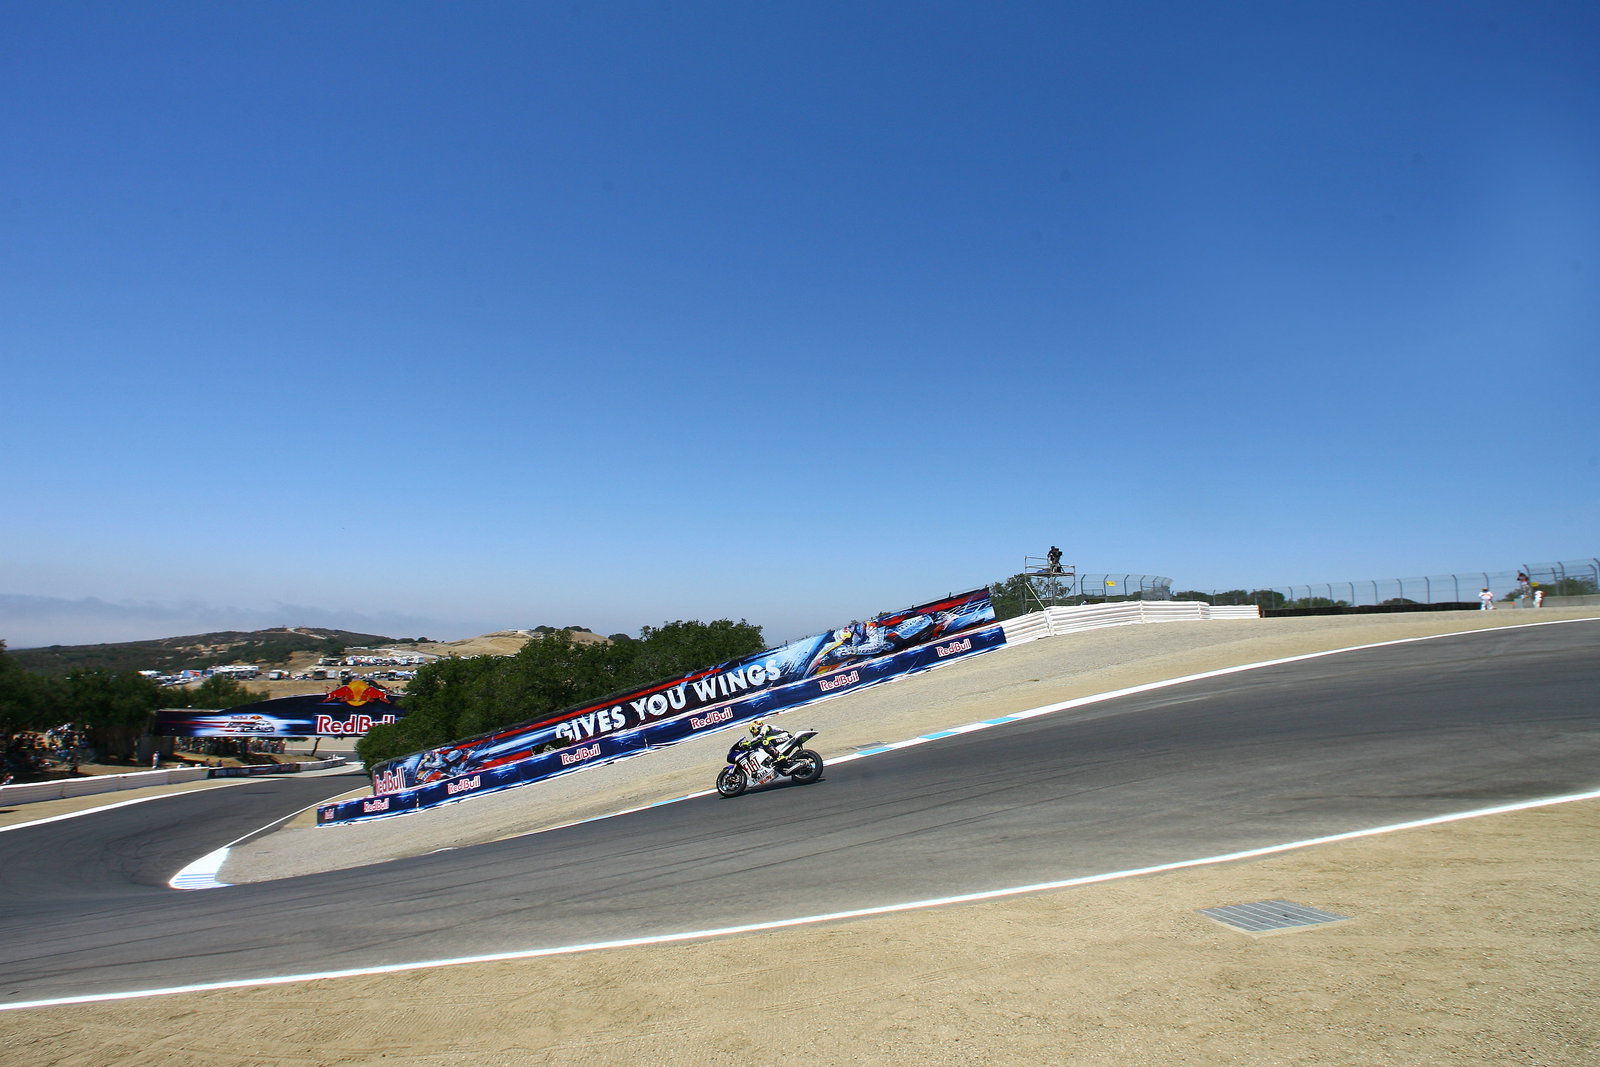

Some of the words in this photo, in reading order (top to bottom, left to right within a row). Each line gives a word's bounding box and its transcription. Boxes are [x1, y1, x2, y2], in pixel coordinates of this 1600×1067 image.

[555, 705, 626, 742] GIVES
[629, 685, 688, 721] YOU
[692, 659, 781, 702] WINGS
[742, 755, 762, 776] FIAT
